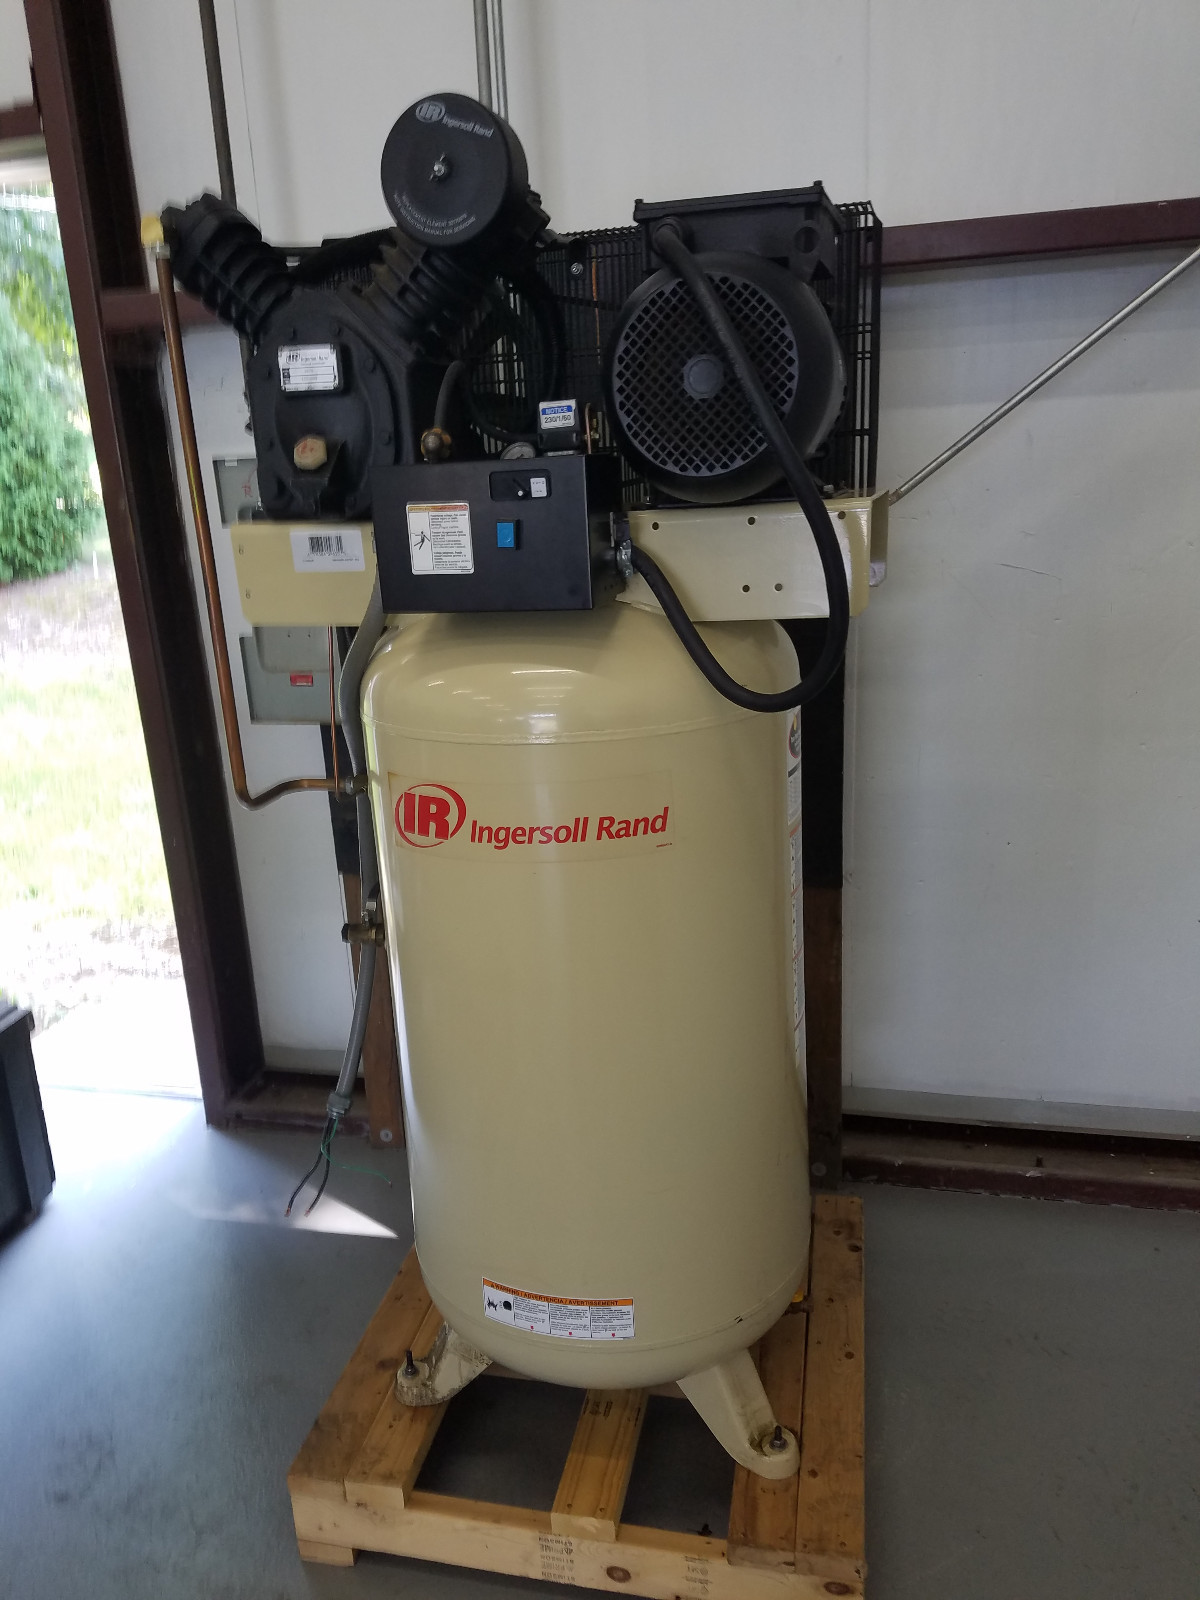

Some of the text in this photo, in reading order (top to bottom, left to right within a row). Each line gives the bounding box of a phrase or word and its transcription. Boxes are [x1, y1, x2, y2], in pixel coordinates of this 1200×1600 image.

[443, 115, 494, 138] Ingersoll Rand
[545, 406, 568, 415] NOTICE
[470, 806, 669, 850] Ingersoll Rand
[495, 1283, 520, 1296] WARNING
[524, 1291, 564, 1305] ADVERTENCIA
[568, 1299, 619, 1307] AVERTISSEMENT
